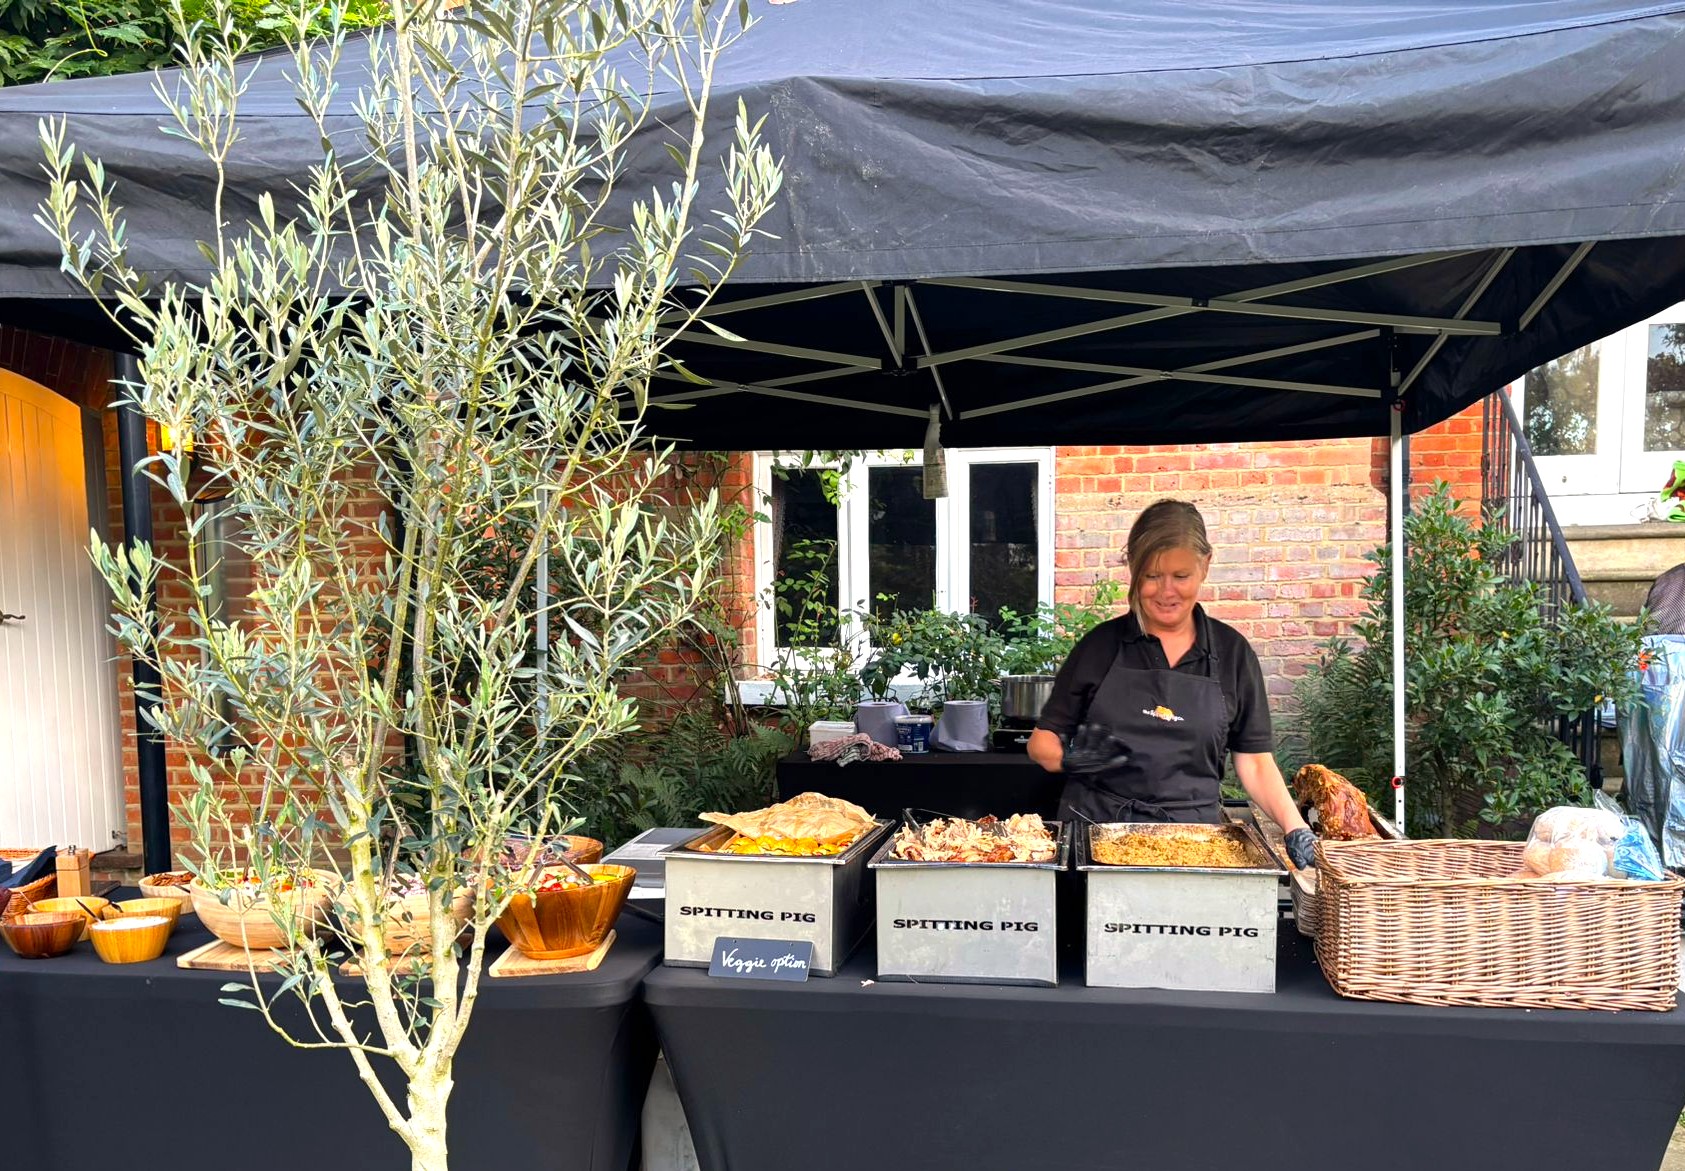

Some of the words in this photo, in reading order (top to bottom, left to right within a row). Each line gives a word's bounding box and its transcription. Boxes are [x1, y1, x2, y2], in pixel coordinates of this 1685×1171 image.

[680, 906, 774, 920] SPITTING
[781, 912, 816, 923] PIG
[893, 918, 993, 931] SPITTING
[1001, 921, 1039, 932] PIG
[1104, 923, 1211, 936] SPITTING
[1219, 926, 1259, 938] PIG
[722, 948, 767, 973] Veggie
[771, 953, 807, 973] option
